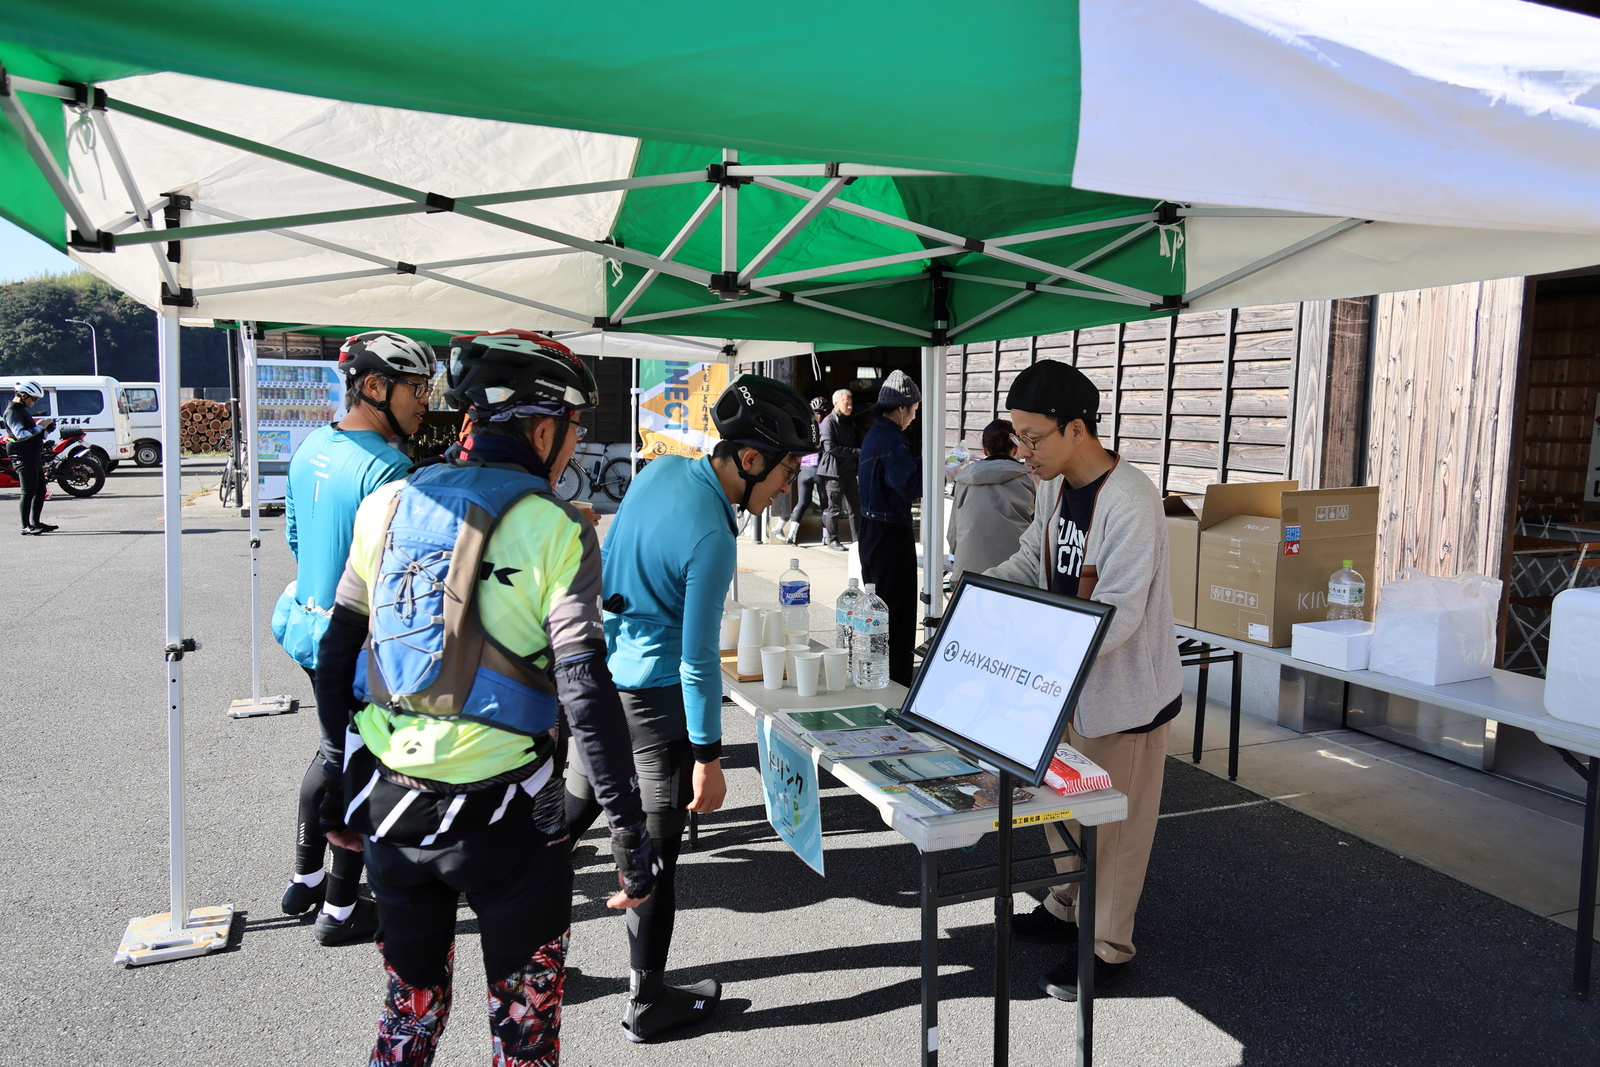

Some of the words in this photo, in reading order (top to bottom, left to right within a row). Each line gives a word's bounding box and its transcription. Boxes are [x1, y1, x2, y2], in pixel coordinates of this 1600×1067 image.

[960, 649, 1032, 686] HAYASHITEI
[1032, 675, 1062, 697] Cafe
[769, 751, 803, 795] ドリンク
